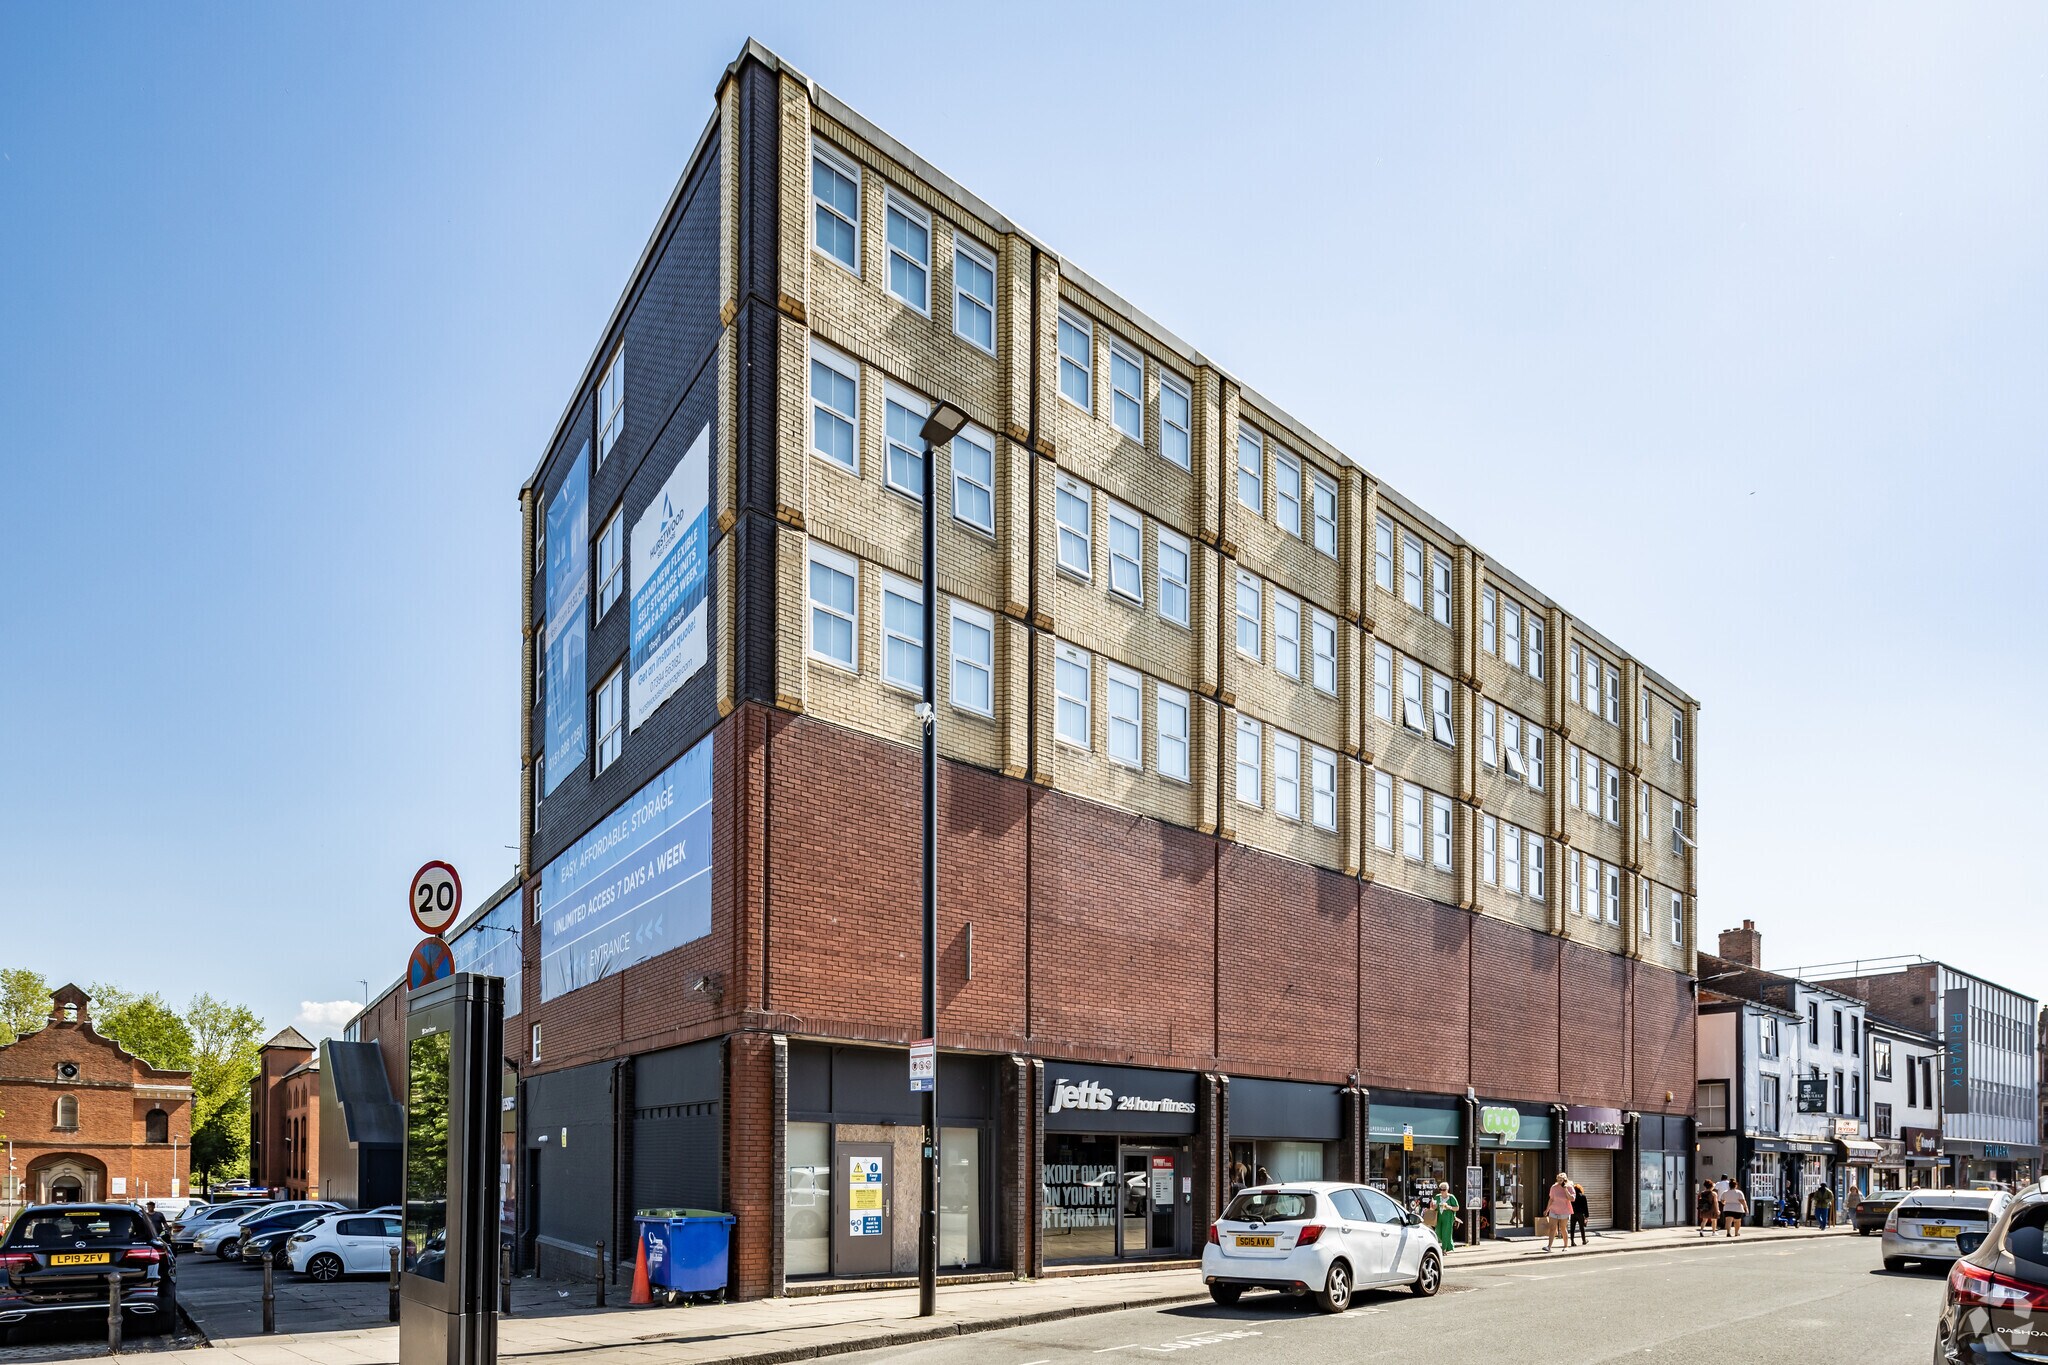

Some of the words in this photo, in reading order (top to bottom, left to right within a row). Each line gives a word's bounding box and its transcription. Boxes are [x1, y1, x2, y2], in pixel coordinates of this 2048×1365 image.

[650, 509, 684, 560] HURSTWOOD
[638, 580, 656, 611] BRAND
[657, 561, 671, 588] NEW
[671, 527, 698, 570] FLEXIBLE
[638, 603, 650, 626] SELF
[650, 570, 677, 611] STORAGE
[677, 547, 697, 578] UNITS
[635, 621, 651, 645] FROM
[651, 597, 668, 626] £4.95
[668, 585, 679, 608] PER
[638, 669, 648, 686] Get
[648, 663, 656, 675] an
[656, 643, 676, 669] instant
[676, 616, 696, 649] quote!
[561, 857, 578, 883] EASY,
[580, 820, 630, 871] AFFORDABLE,
[631, 784, 674, 832] STORAGE
[418, 881, 454, 912] 20
[553, 903, 587, 936] UNLIMITED
[587, 884, 616, 917] ACCESS
[617, 880, 623, 899] 7
[623, 866, 646, 895] DAYS
[647, 861, 655, 880] A
[657, 840, 686, 874] WEEK
[589, 931, 631, 967] ENTRANCE
[1951, 1013, 1963, 1087] PRIMARK
[1048, 1078, 1114, 1114] jetts
[1486, 1113, 1517, 1128] FOOD
[1567, 1120, 1587, 1133] THE
[1985, 1144, 2010, 1158] PRIMARK
[1081, 1165, 1097, 1184] ON
[1062, 1186, 1095, 1206] YOUR
[1051, 1207, 1095, 1228] TERMS
[57, 1255, 81, 1264] LP19
[84, 1254, 104, 1263] ZFV
[1240, 1237, 1255, 1246] SG15
[1256, 1238, 1270, 1246] AVX
